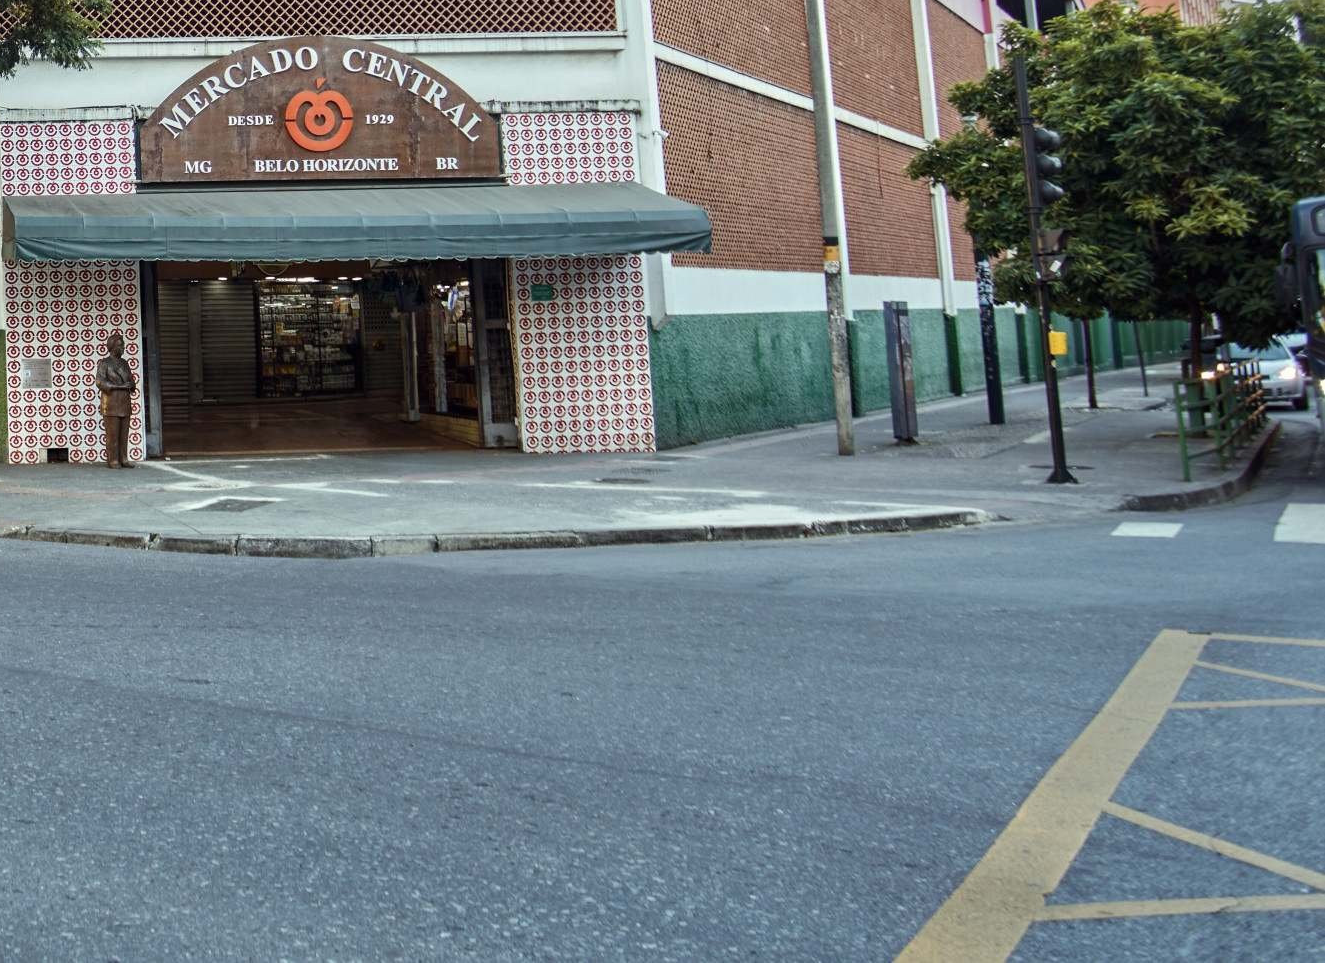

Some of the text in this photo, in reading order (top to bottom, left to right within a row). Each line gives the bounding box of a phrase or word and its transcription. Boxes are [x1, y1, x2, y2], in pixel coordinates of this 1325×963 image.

[158, 46, 482, 142] MERCADO CENTRAL
[228, 114, 394, 126] DESDE 1929
[184, 157, 459, 174] MG BELO HORIZONTE BR
